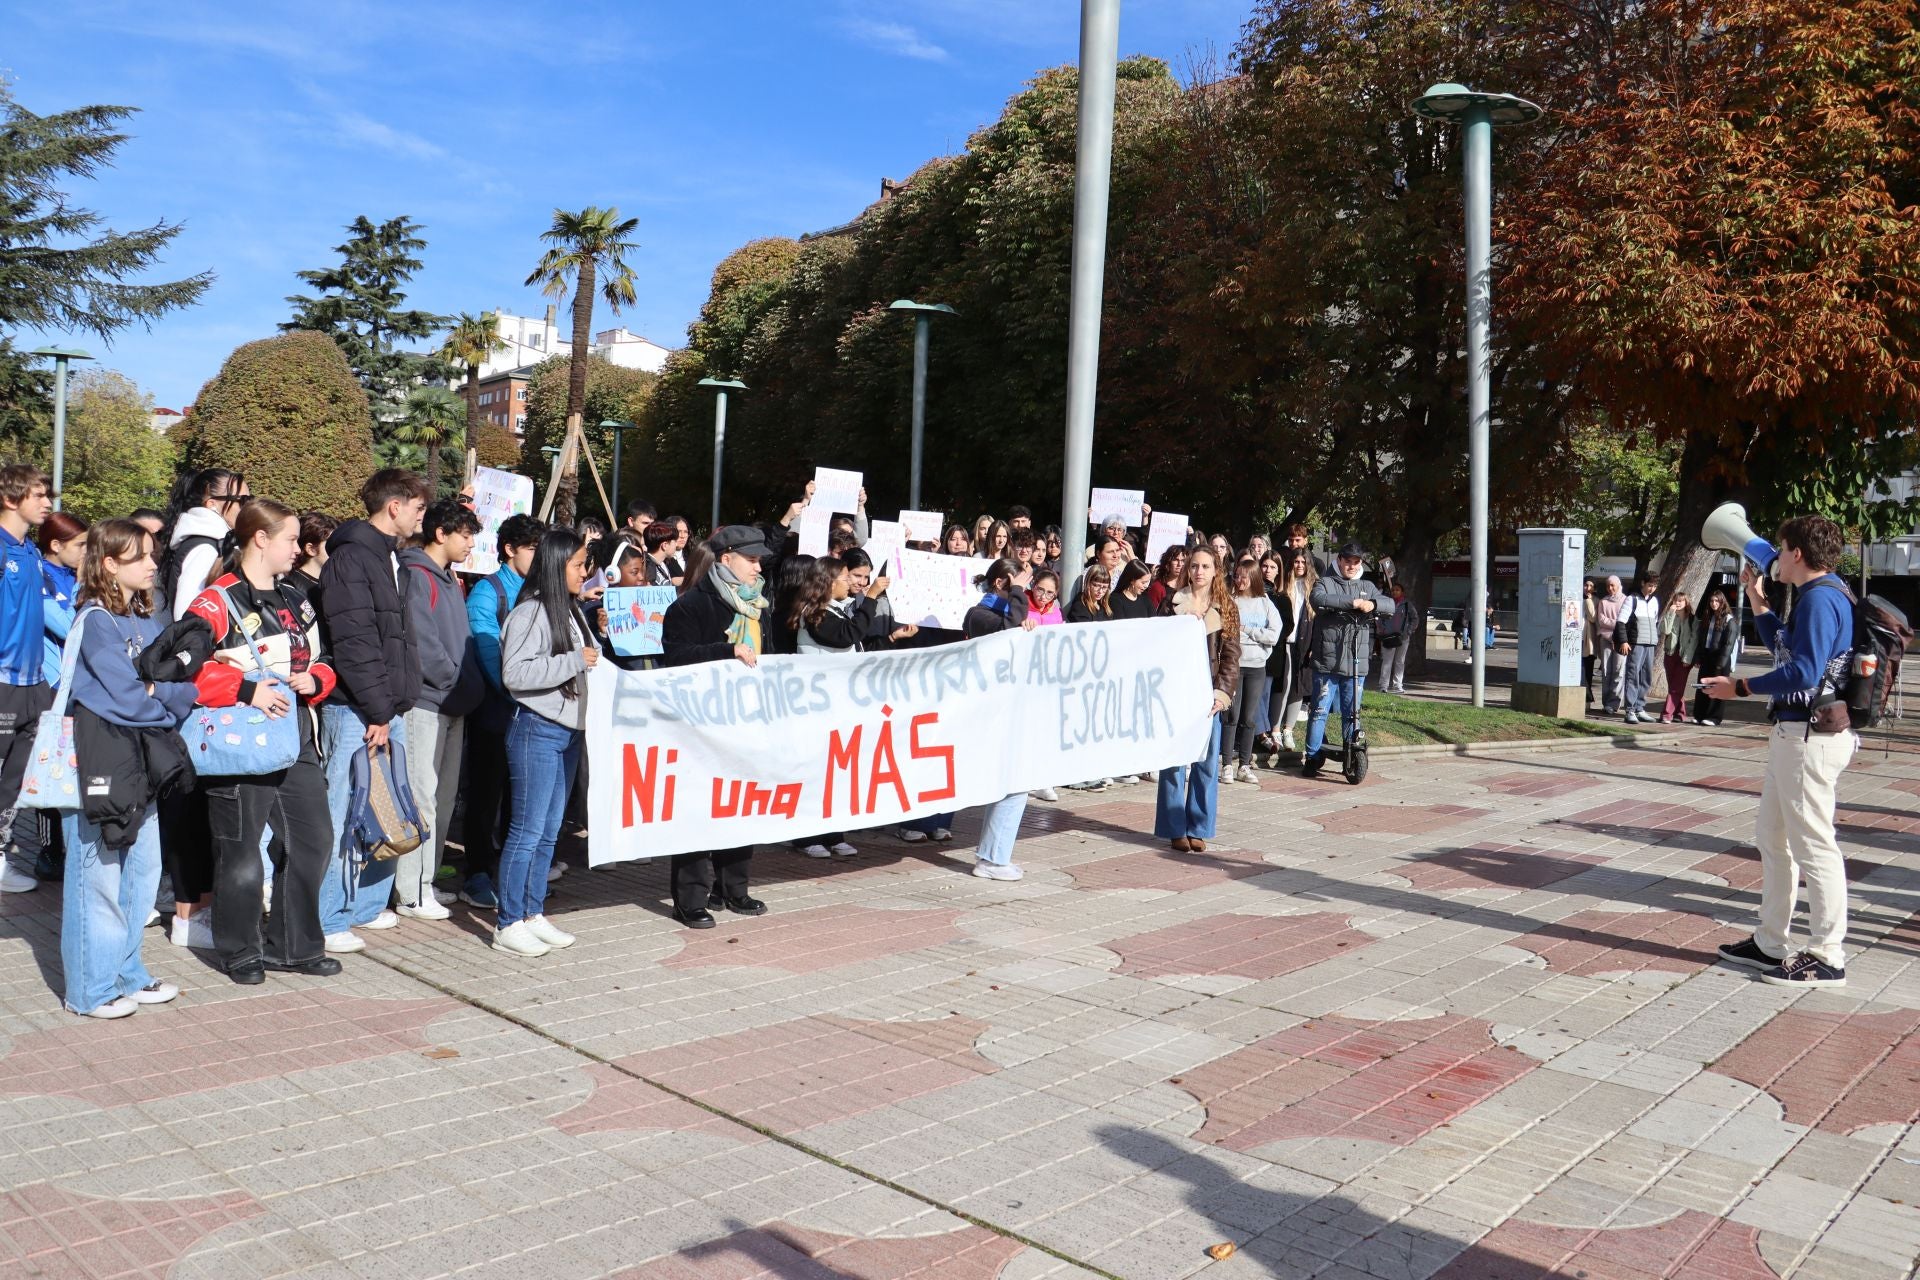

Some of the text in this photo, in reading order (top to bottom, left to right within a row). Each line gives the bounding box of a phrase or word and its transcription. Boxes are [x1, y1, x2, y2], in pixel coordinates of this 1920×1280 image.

[607, 590, 626, 611] EL
[1722, 573, 1738, 585] BIN
[848, 642, 988, 707] CONTRA
[995, 639, 1016, 685] el
[1026, 629, 1109, 686] ACOSO
[1059, 667, 1174, 751] ESCOLAR
[622, 743, 678, 828] Ni
[823, 704, 955, 819] MÁS
